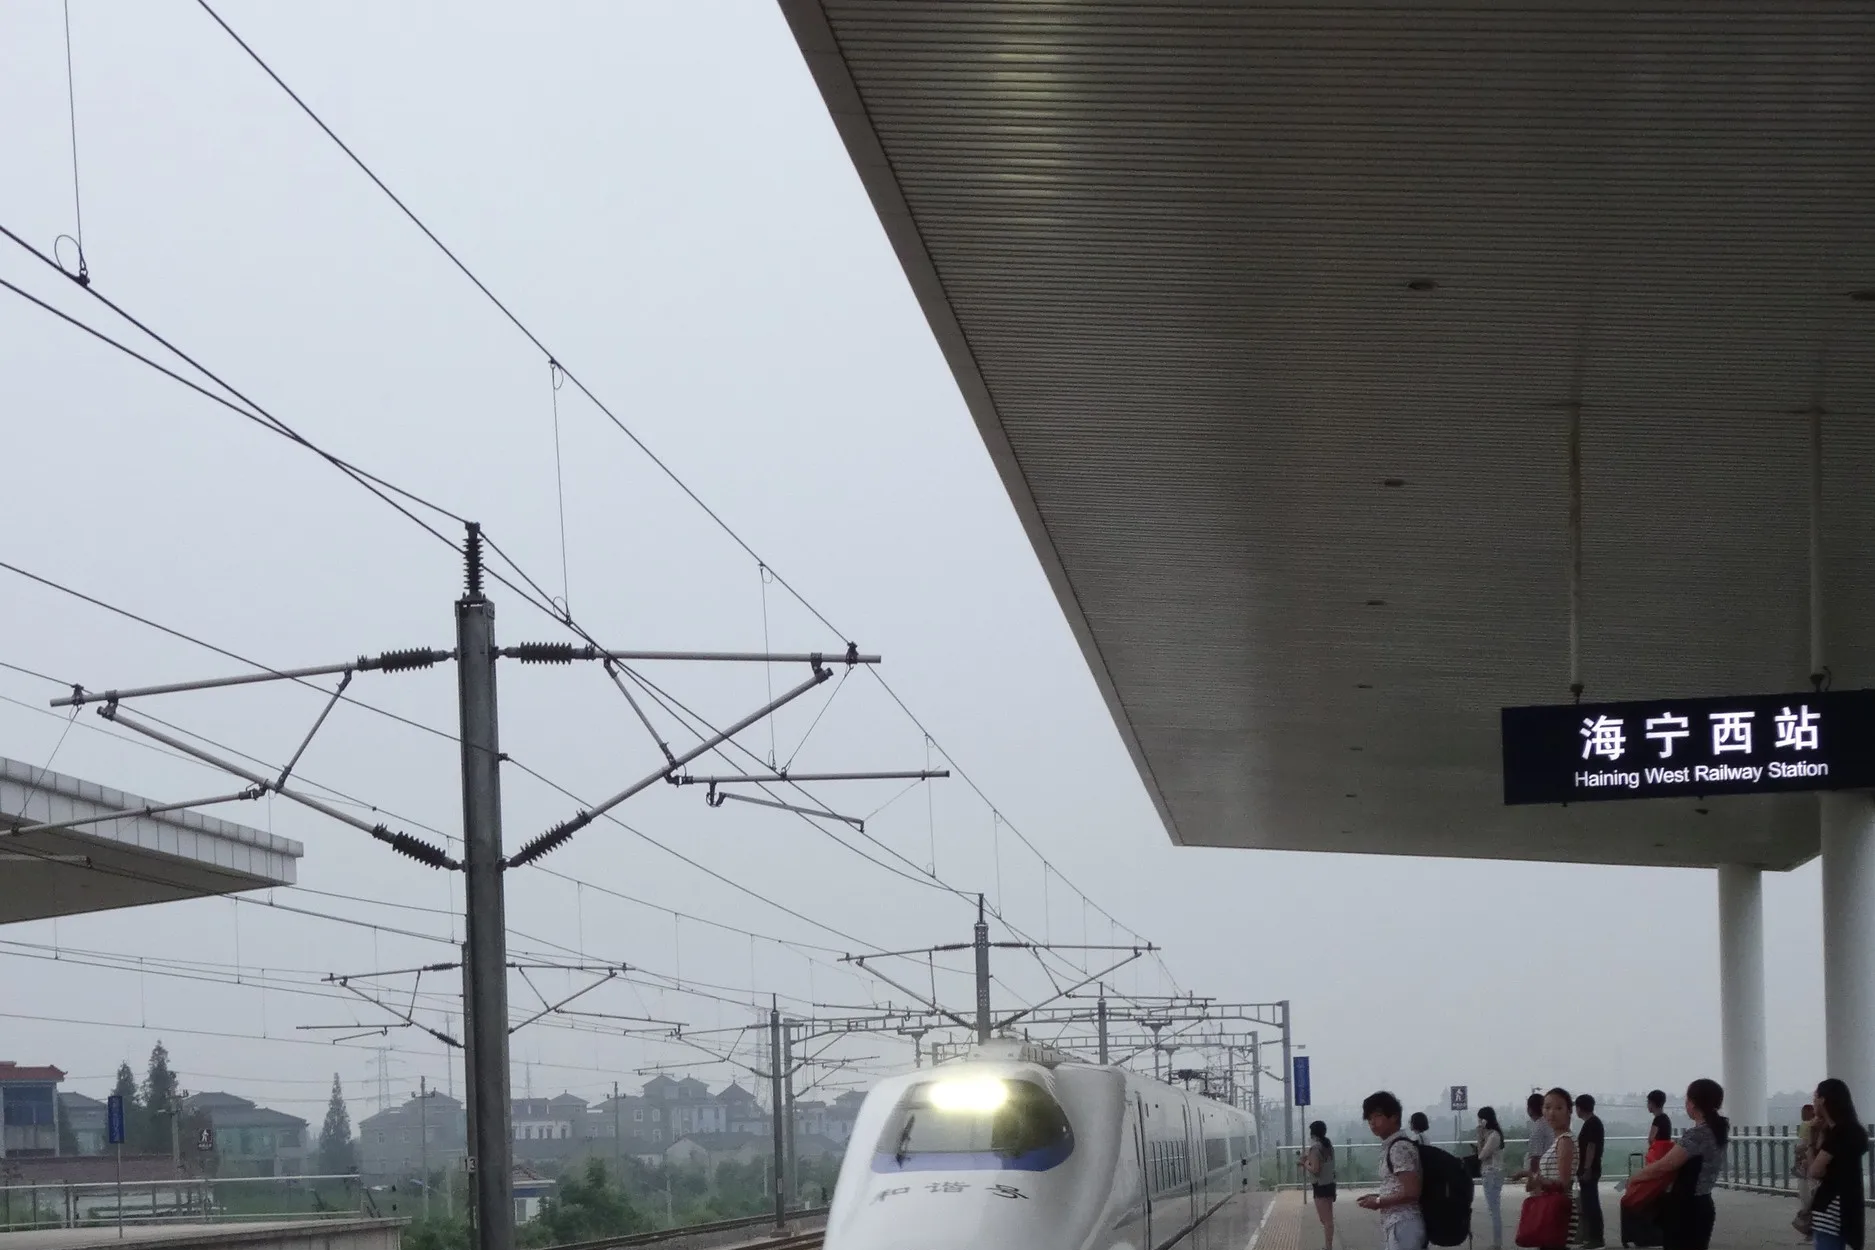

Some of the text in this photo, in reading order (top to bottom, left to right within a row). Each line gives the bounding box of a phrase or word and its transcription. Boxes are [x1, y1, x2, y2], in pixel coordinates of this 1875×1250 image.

[1579, 705, 1822, 761] 海宁西站
[1574, 760, 1829, 789] Haining West Railway Station
